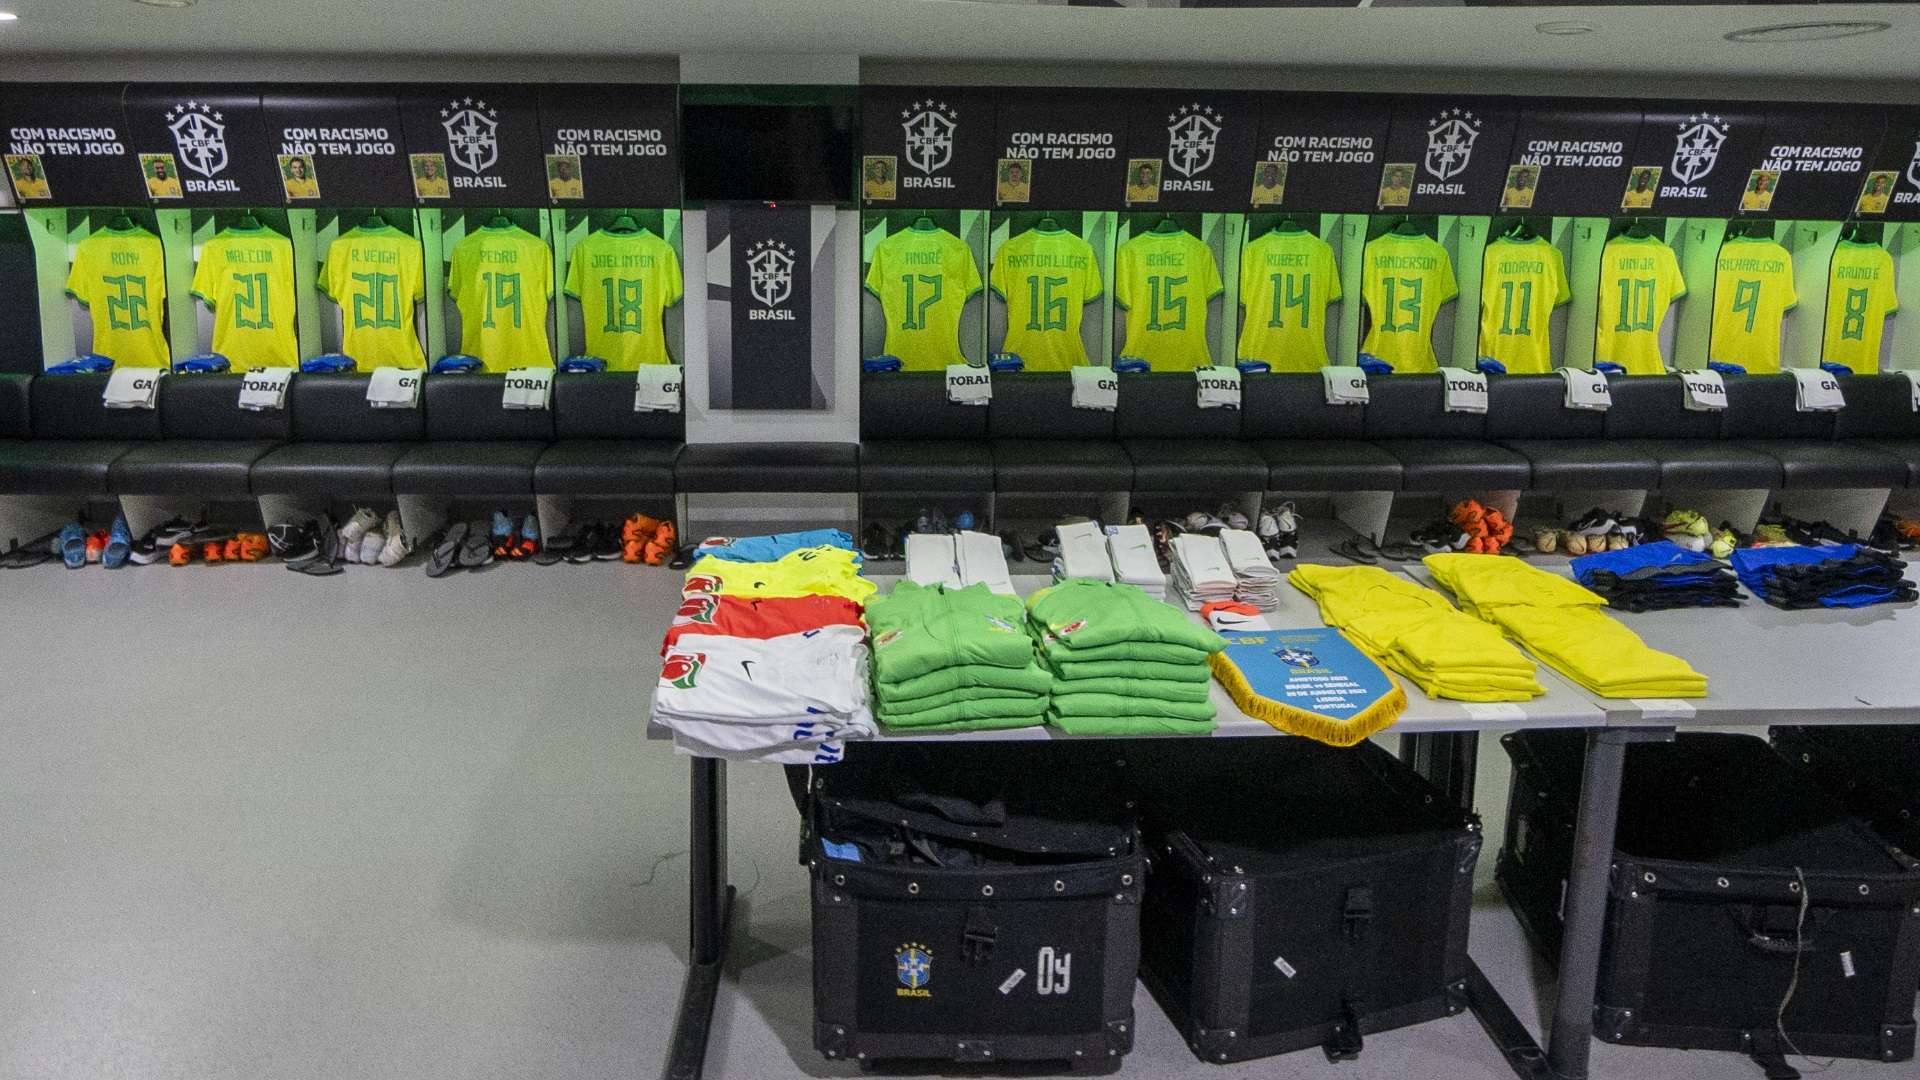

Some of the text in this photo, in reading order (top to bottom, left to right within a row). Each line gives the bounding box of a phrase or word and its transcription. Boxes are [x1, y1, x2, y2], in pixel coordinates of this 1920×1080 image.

[11, 128, 117, 141] COM RACISMO
[283, 128, 389, 141] COM RACISMO
[557, 128, 662, 141] COM RACISMO
[1011, 132, 1113, 145] COM RACISMO
[10, 141, 125, 155] NÃO TEM JOGO
[281, 141, 396, 155] NÃO TEM JOGO
[553, 142, 668, 156] NÃO TEM JOGO
[1274, 136, 1374, 149] COM RACISMO
[1528, 140, 1624, 153] COM RACISMO
[1006, 145, 1116, 159] NÃO TEM JOGO
[1267, 148, 1375, 163] NÃO TEM JOGO
[1770, 146, 1863, 160] COM RACISMO
[1520, 152, 1624, 167] NÃO TEM JOGO
[1761, 158, 1863, 173] NÃO TEM JOGO
[186, 179, 241, 193] BRASIL
[453, 176, 507, 188] BRASIL
[903, 177, 956, 189] BRASIL
[1163, 180, 1214, 191] BRASIL
[1416, 184, 1466, 196] BRASIL
[1660, 186, 1708, 199] BRASIL
[480, 250, 517, 264] PEDRO
[762, 272, 779, 281] CBF
[103, 274, 151, 330] 22
[233, 272, 274, 330] 21
[352, 272, 401, 329] 20
[482, 271, 522, 329] 19
[602, 277, 643, 334] 18
[902, 273, 942, 330] 17
[1026, 276, 1068, 331] 16
[1146, 276, 1187, 331] 15
[1267, 273, 1310, 329] 14
[1380, 277, 1423, 333] 13
[1615, 278, 1656, 333] 10
[1732, 279, 1761, 333] 9
[749, 309, 796, 321] BRASIL
[1499, 281, 1532, 336] 11
[1841, 288, 1868, 341] 8
[897, 987, 932, 997] BRASIL
